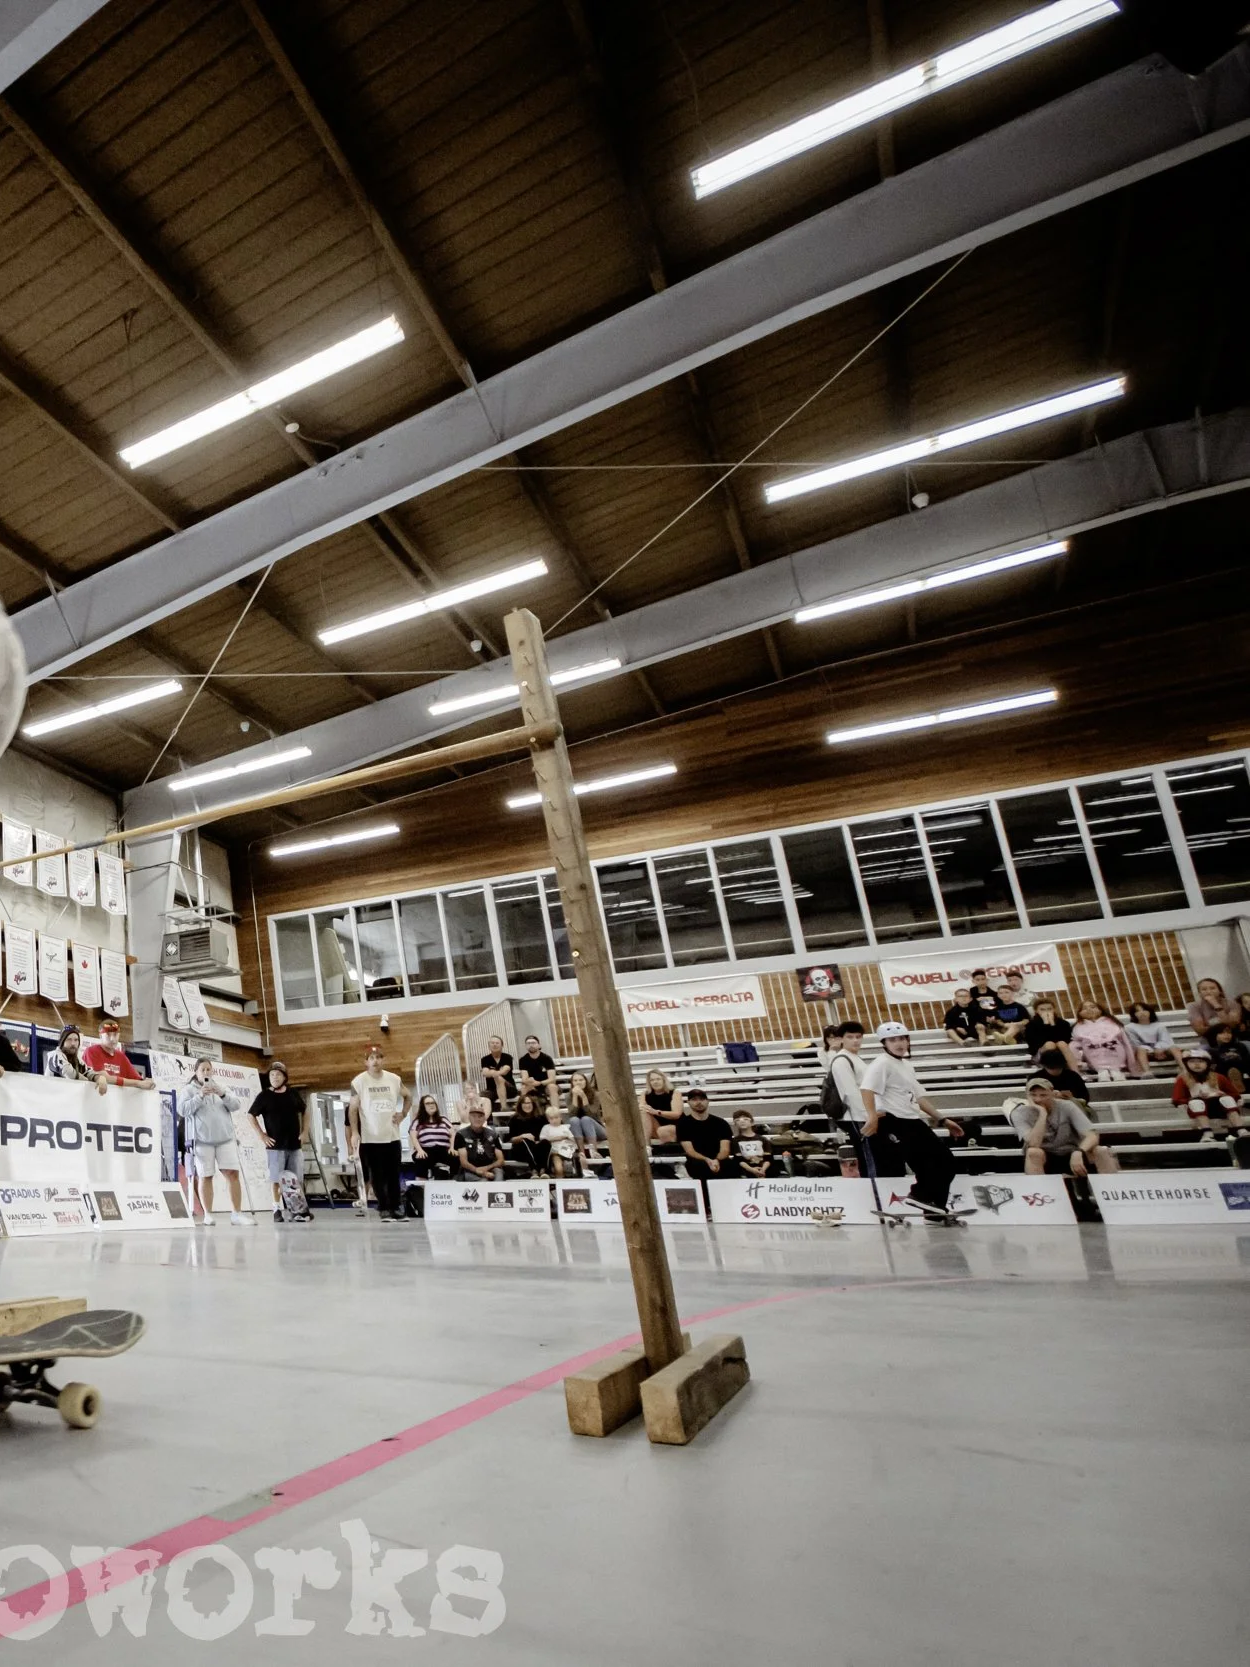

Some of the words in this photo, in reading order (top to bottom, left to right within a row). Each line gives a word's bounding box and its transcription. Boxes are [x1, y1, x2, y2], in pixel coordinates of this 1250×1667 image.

[890, 969, 958, 989] POWELL
[626, 997, 681, 1014] POWELL
[692, 990, 755, 1008] PERALTA
[218, 1070, 245, 1080] COLUMBIA
[10, 1188, 41, 1199] RADIUS
[768, 1183, 813, 1195] Holiday
[814, 1183, 833, 1193] Inn
[1101, 1187, 1212, 1201] QUARTERHORSE
[430, 1192, 452, 1200] Skate
[126, 1200, 160, 1212] TASHME
[430, 1199, 453, 1207] board
[6, 1213, 21, 1221] VAN
[31, 1212, 48, 1220] POLL
